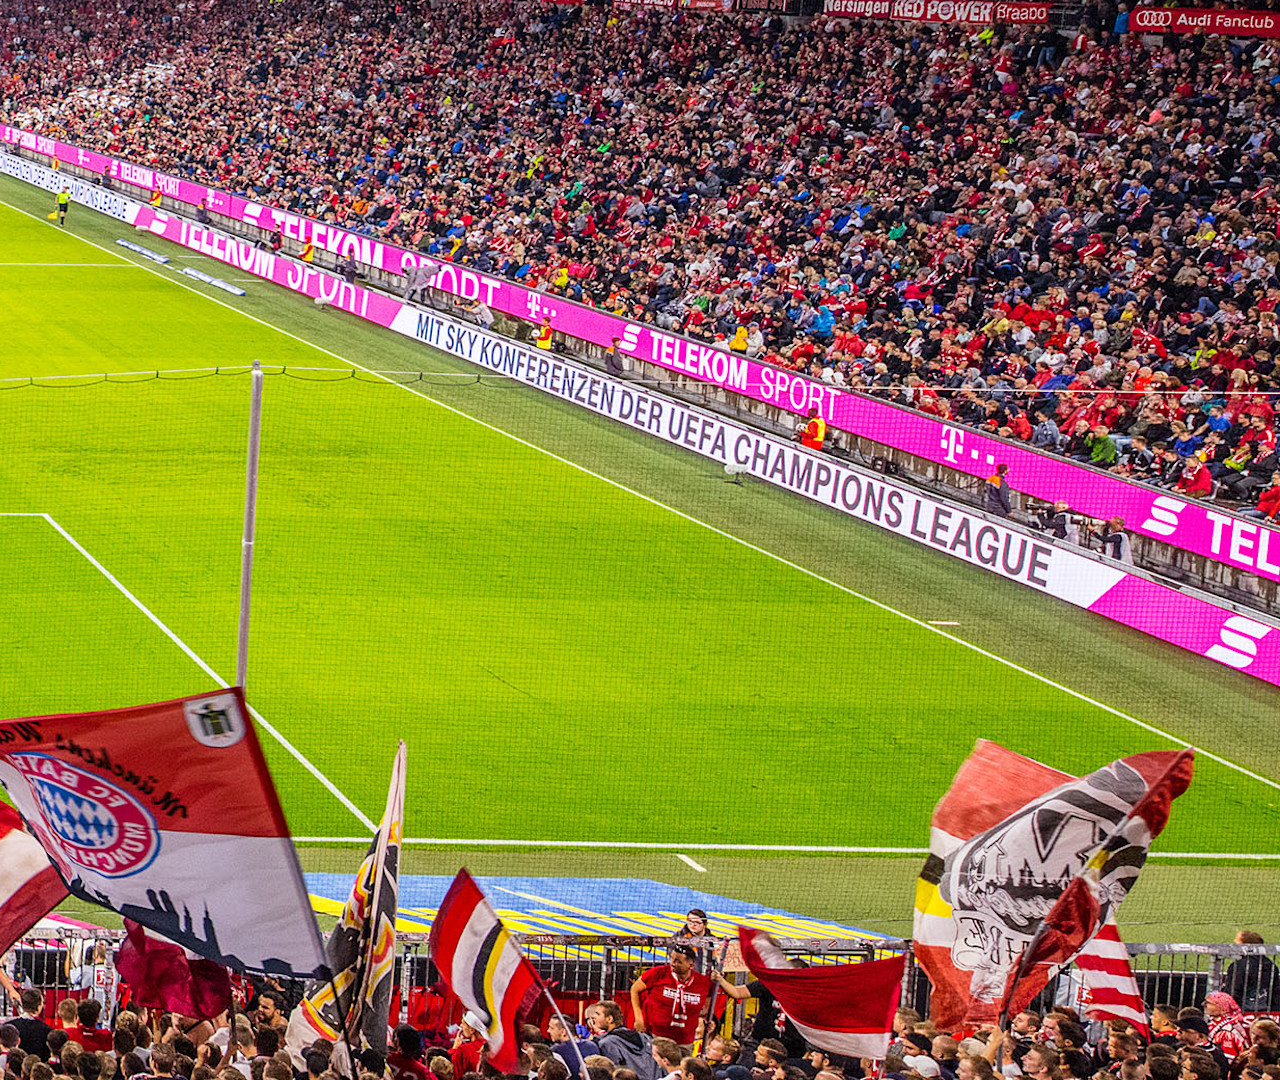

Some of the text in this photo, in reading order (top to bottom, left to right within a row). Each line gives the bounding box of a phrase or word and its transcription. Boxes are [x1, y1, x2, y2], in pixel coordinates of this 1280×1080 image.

[926, 0, 992, 22] POWER
[1176, 12, 1274, 29] Audi Fanclub
[120, 161, 181, 197] TELEKOM SPORT
[181, 221, 276, 280] TELEKOM
[272, 210, 502, 308] TELEKOM SORT
[649, 331, 842, 421] TELEKOM SPORT
[416, 313, 1053, 587] MIT SKY KONFERENZEN DER UEFA CHAMPIONS LEAGUE
